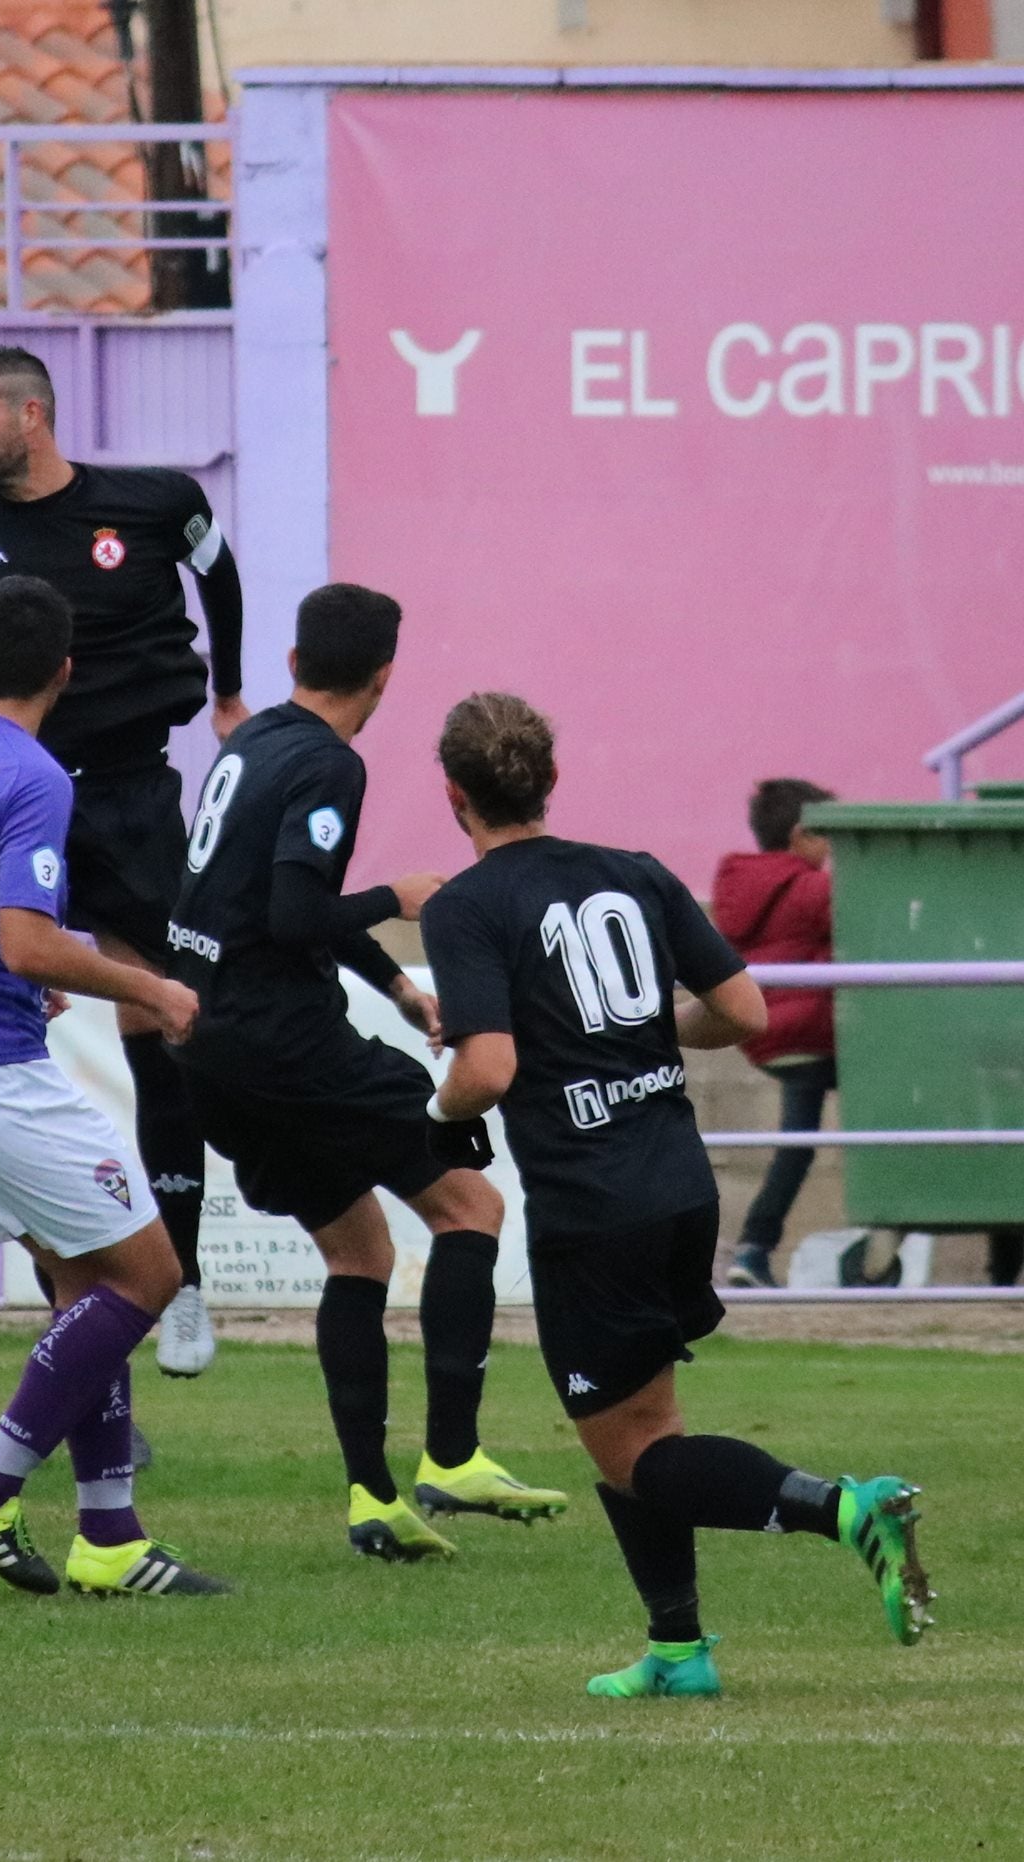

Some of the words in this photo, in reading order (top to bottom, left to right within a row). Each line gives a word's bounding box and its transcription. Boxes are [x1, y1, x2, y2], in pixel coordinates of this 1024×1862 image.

[571, 329, 677, 416] EL
[188, 754, 243, 873] 8
[540, 892, 660, 1034] 10
[212, 1280, 248, 1293] Fax:
[255, 1279, 285, 1292] 987
[215, 1259, 257, 1273] León
